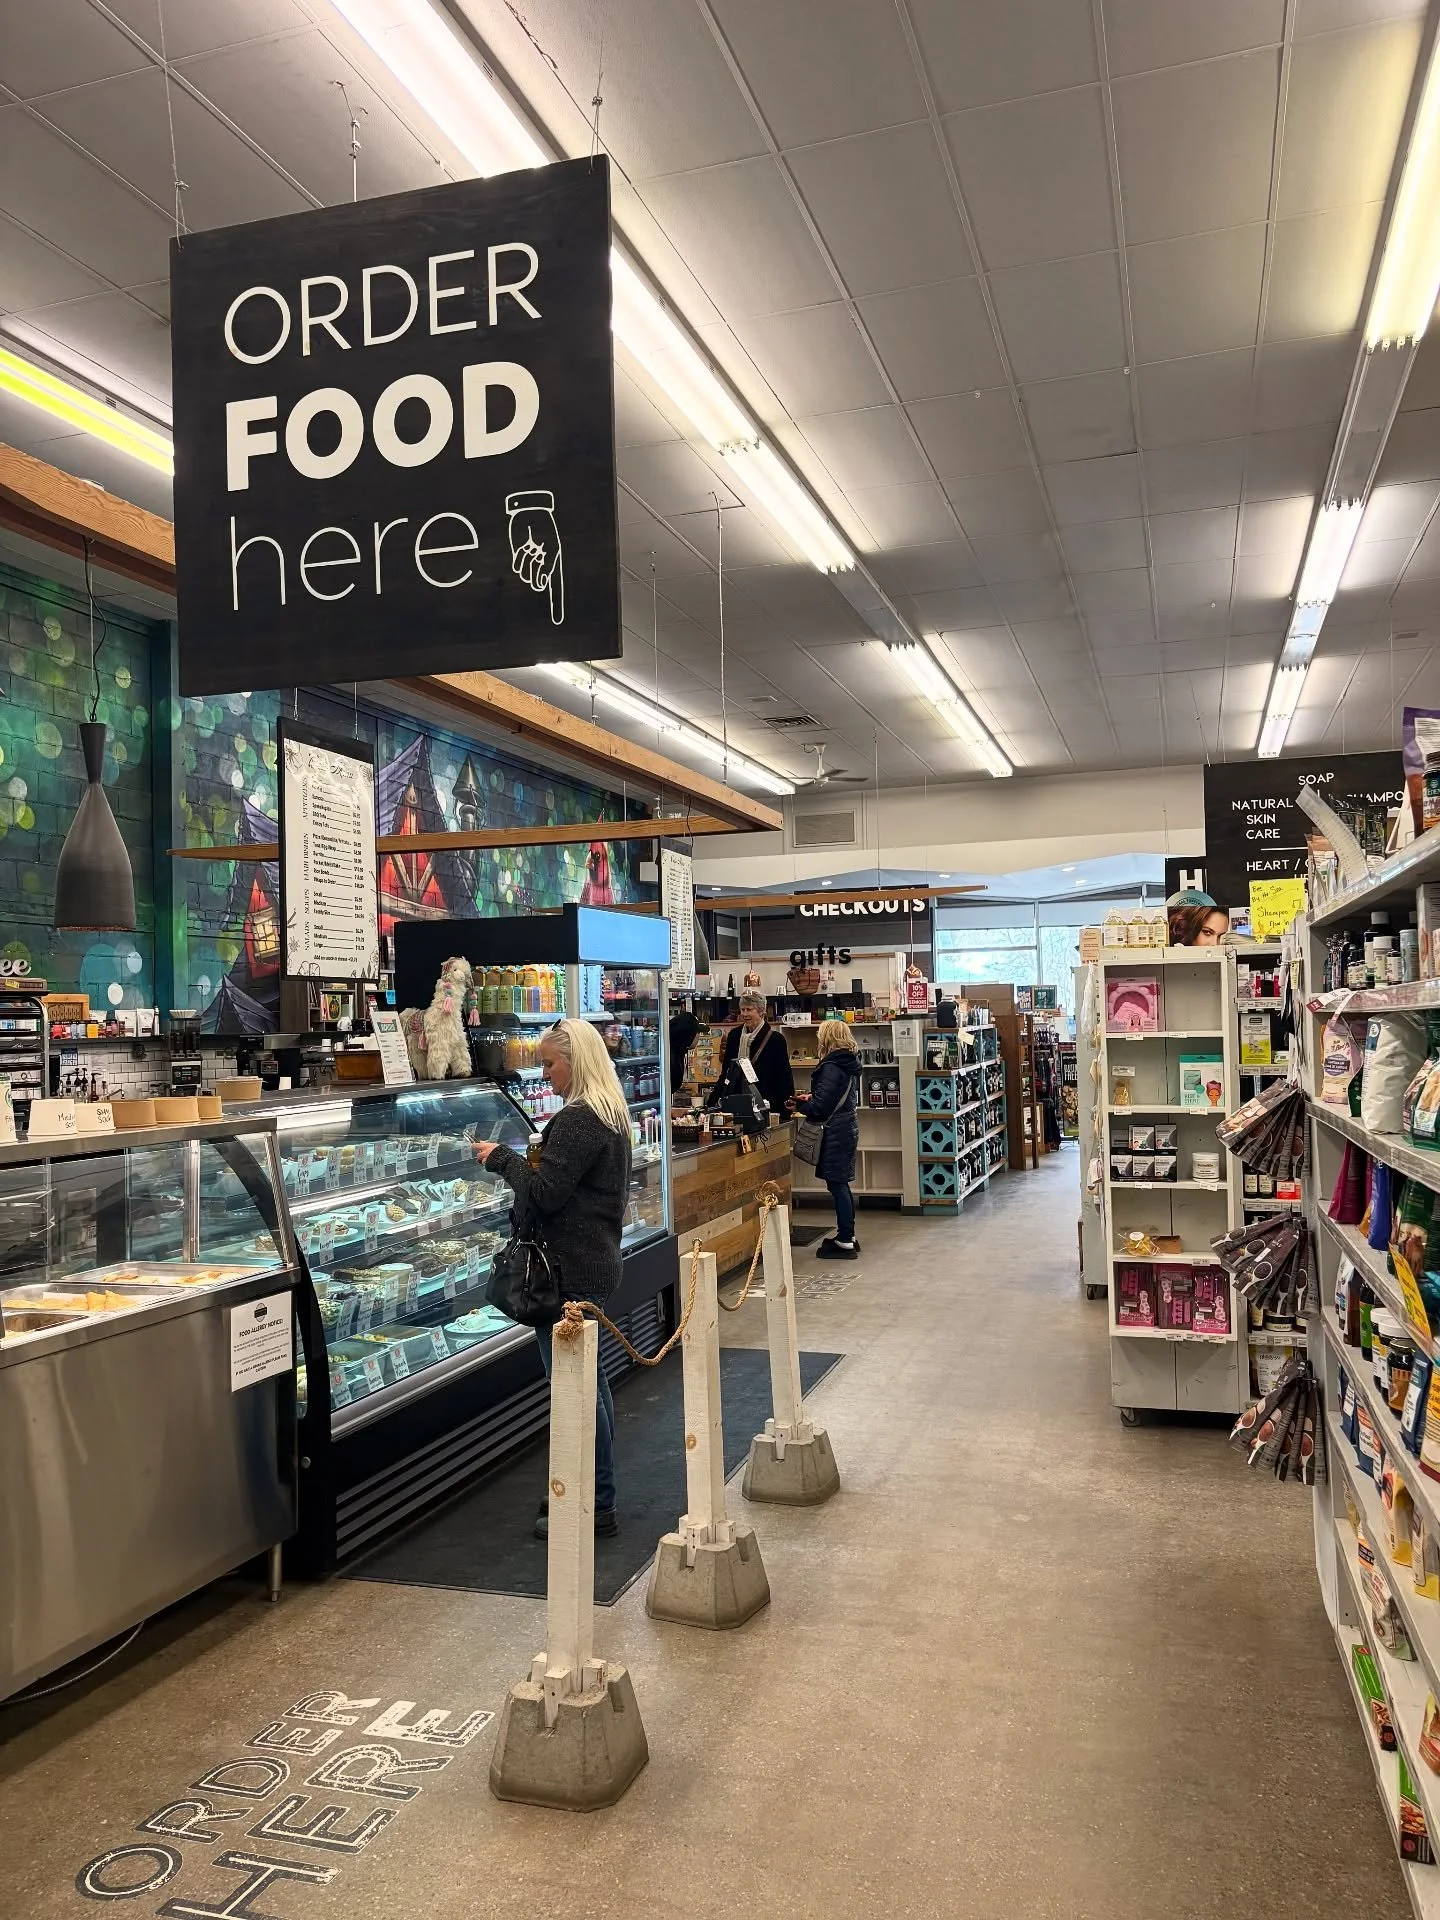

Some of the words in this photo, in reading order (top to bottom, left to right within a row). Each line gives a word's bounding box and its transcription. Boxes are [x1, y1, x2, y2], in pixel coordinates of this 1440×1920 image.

[224, 242, 542, 364] ORDER
[226, 361, 540, 492] FOOD
[230, 512, 479, 611] here
[1298, 772, 1335, 786] SOAP
[1232, 798, 1294, 811] NATURAL
[1246, 814, 1276, 825] SKIN
[1246, 829, 1281, 840] CARE
[1246, 860, 1290, 872] HEART
[799, 899, 926, 917] CHECKOUTS
[789, 943, 852, 967] gifts
[239, 1329, 251, 1338] FOOD
[251, 1322, 267, 1333] ALLERGY
[75, 1690, 381, 1900] ORDER
[154, 1700, 496, 1920] HERE
